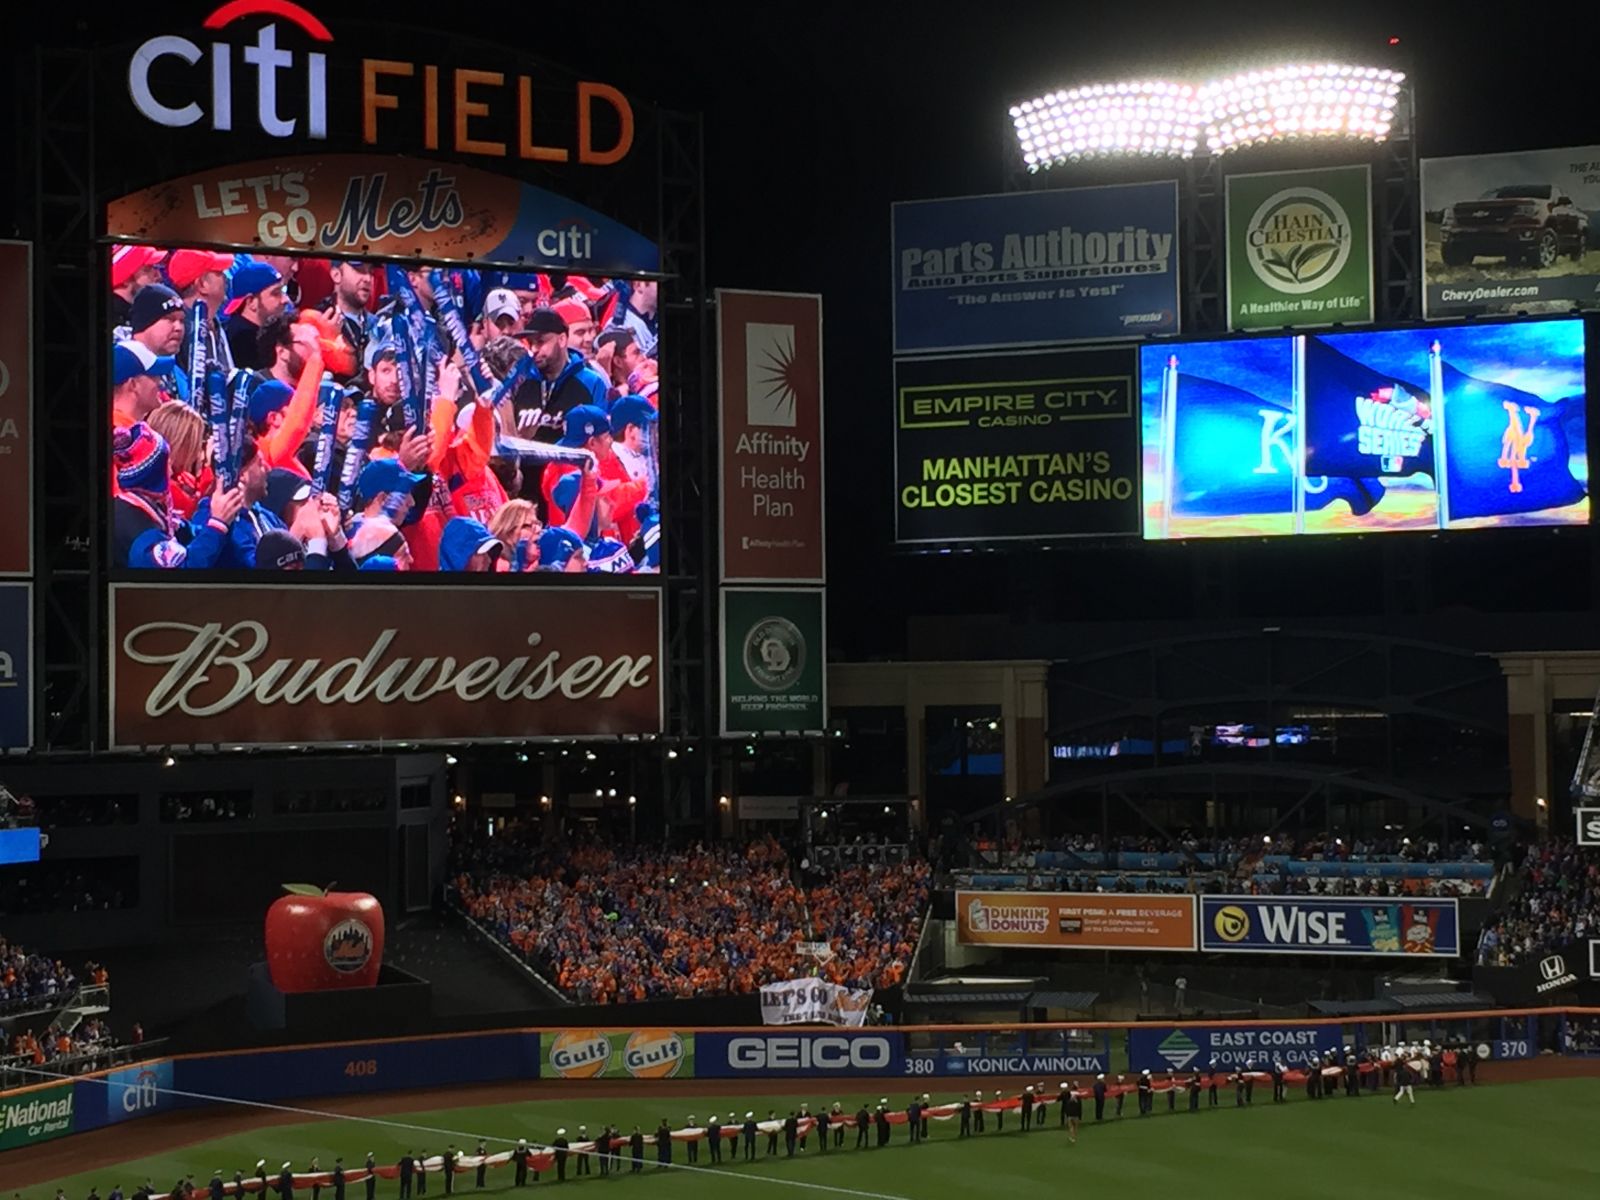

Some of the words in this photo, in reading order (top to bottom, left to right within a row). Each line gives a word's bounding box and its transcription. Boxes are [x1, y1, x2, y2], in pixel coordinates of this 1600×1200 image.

[129, 22, 327, 139] citi
[362, 58, 634, 165] FIELD
[193, 171, 310, 219] LET'S
[258, 208, 317, 247] GO
[320, 168, 464, 249] Mets
[1273, 214, 1323, 230] HAIN
[537, 226, 593, 259] citi
[1249, 223, 1344, 247] CELESTIAL
[902, 241, 993, 277] Parts
[1001, 226, 1173, 270] Authority
[906, 275, 955, 288] Auto
[961, 272, 1018, 285] Parts
[1023, 262, 1163, 280] Superstores
[990, 291, 1055, 303] Answer
[1441, 286, 1539, 302] ChevyDealer.com
[1240, 305, 1248, 315] A
[1250, 301, 1299, 314] Healthier
[1301, 299, 1323, 312] Way
[1326, 298, 1337, 308] of
[913, 394, 1035, 415] EMPIRE
[1044, 389, 1118, 409] CITY
[977, 414, 1052, 428] CASINO
[735, 431, 810, 463] Affinity
[1357, 419, 1426, 457] SERIES
[740, 465, 806, 490] Health
[923, 452, 1111, 481] MANHATTAN'S
[752, 493, 794, 517] Plan
[901, 482, 1022, 508] CLOSEST
[1029, 478, 1133, 503] CASINO
[123, 620, 653, 717] Budweiser
[991, 907, 1049, 919] DUNKIN'
[991, 919, 1046, 931] DONUTS
[1116, 909, 1137, 917] FREE
[1139, 909, 1183, 918] BEVERAGE
[1258, 905, 1347, 944] WISE
[1536, 973, 1578, 993] HONDA
[1210, 1032, 1256, 1046] EAST
[1259, 1031, 1318, 1045] COAST
[1500, 1041, 1527, 1057] 370
[553, 1042, 608, 1067] Gulf
[627, 1041, 680, 1068] Gulf
[728, 1037, 890, 1069] GEICO
[904, 1057, 934, 1073] 380
[968, 1056, 1030, 1072] KONICA
[1035, 1055, 1102, 1072] MINOLTA
[1210, 1050, 1270, 1064] POWER
[1272, 1050, 1282, 1063] &
[1286, 1049, 1318, 1063] GAS
[345, 1059, 377, 1077] 408
[123, 1076, 157, 1113] citi
[5, 1093, 73, 1129] National
[28, 1124, 42, 1137] Car
[43, 1118, 70, 1134] Rental
